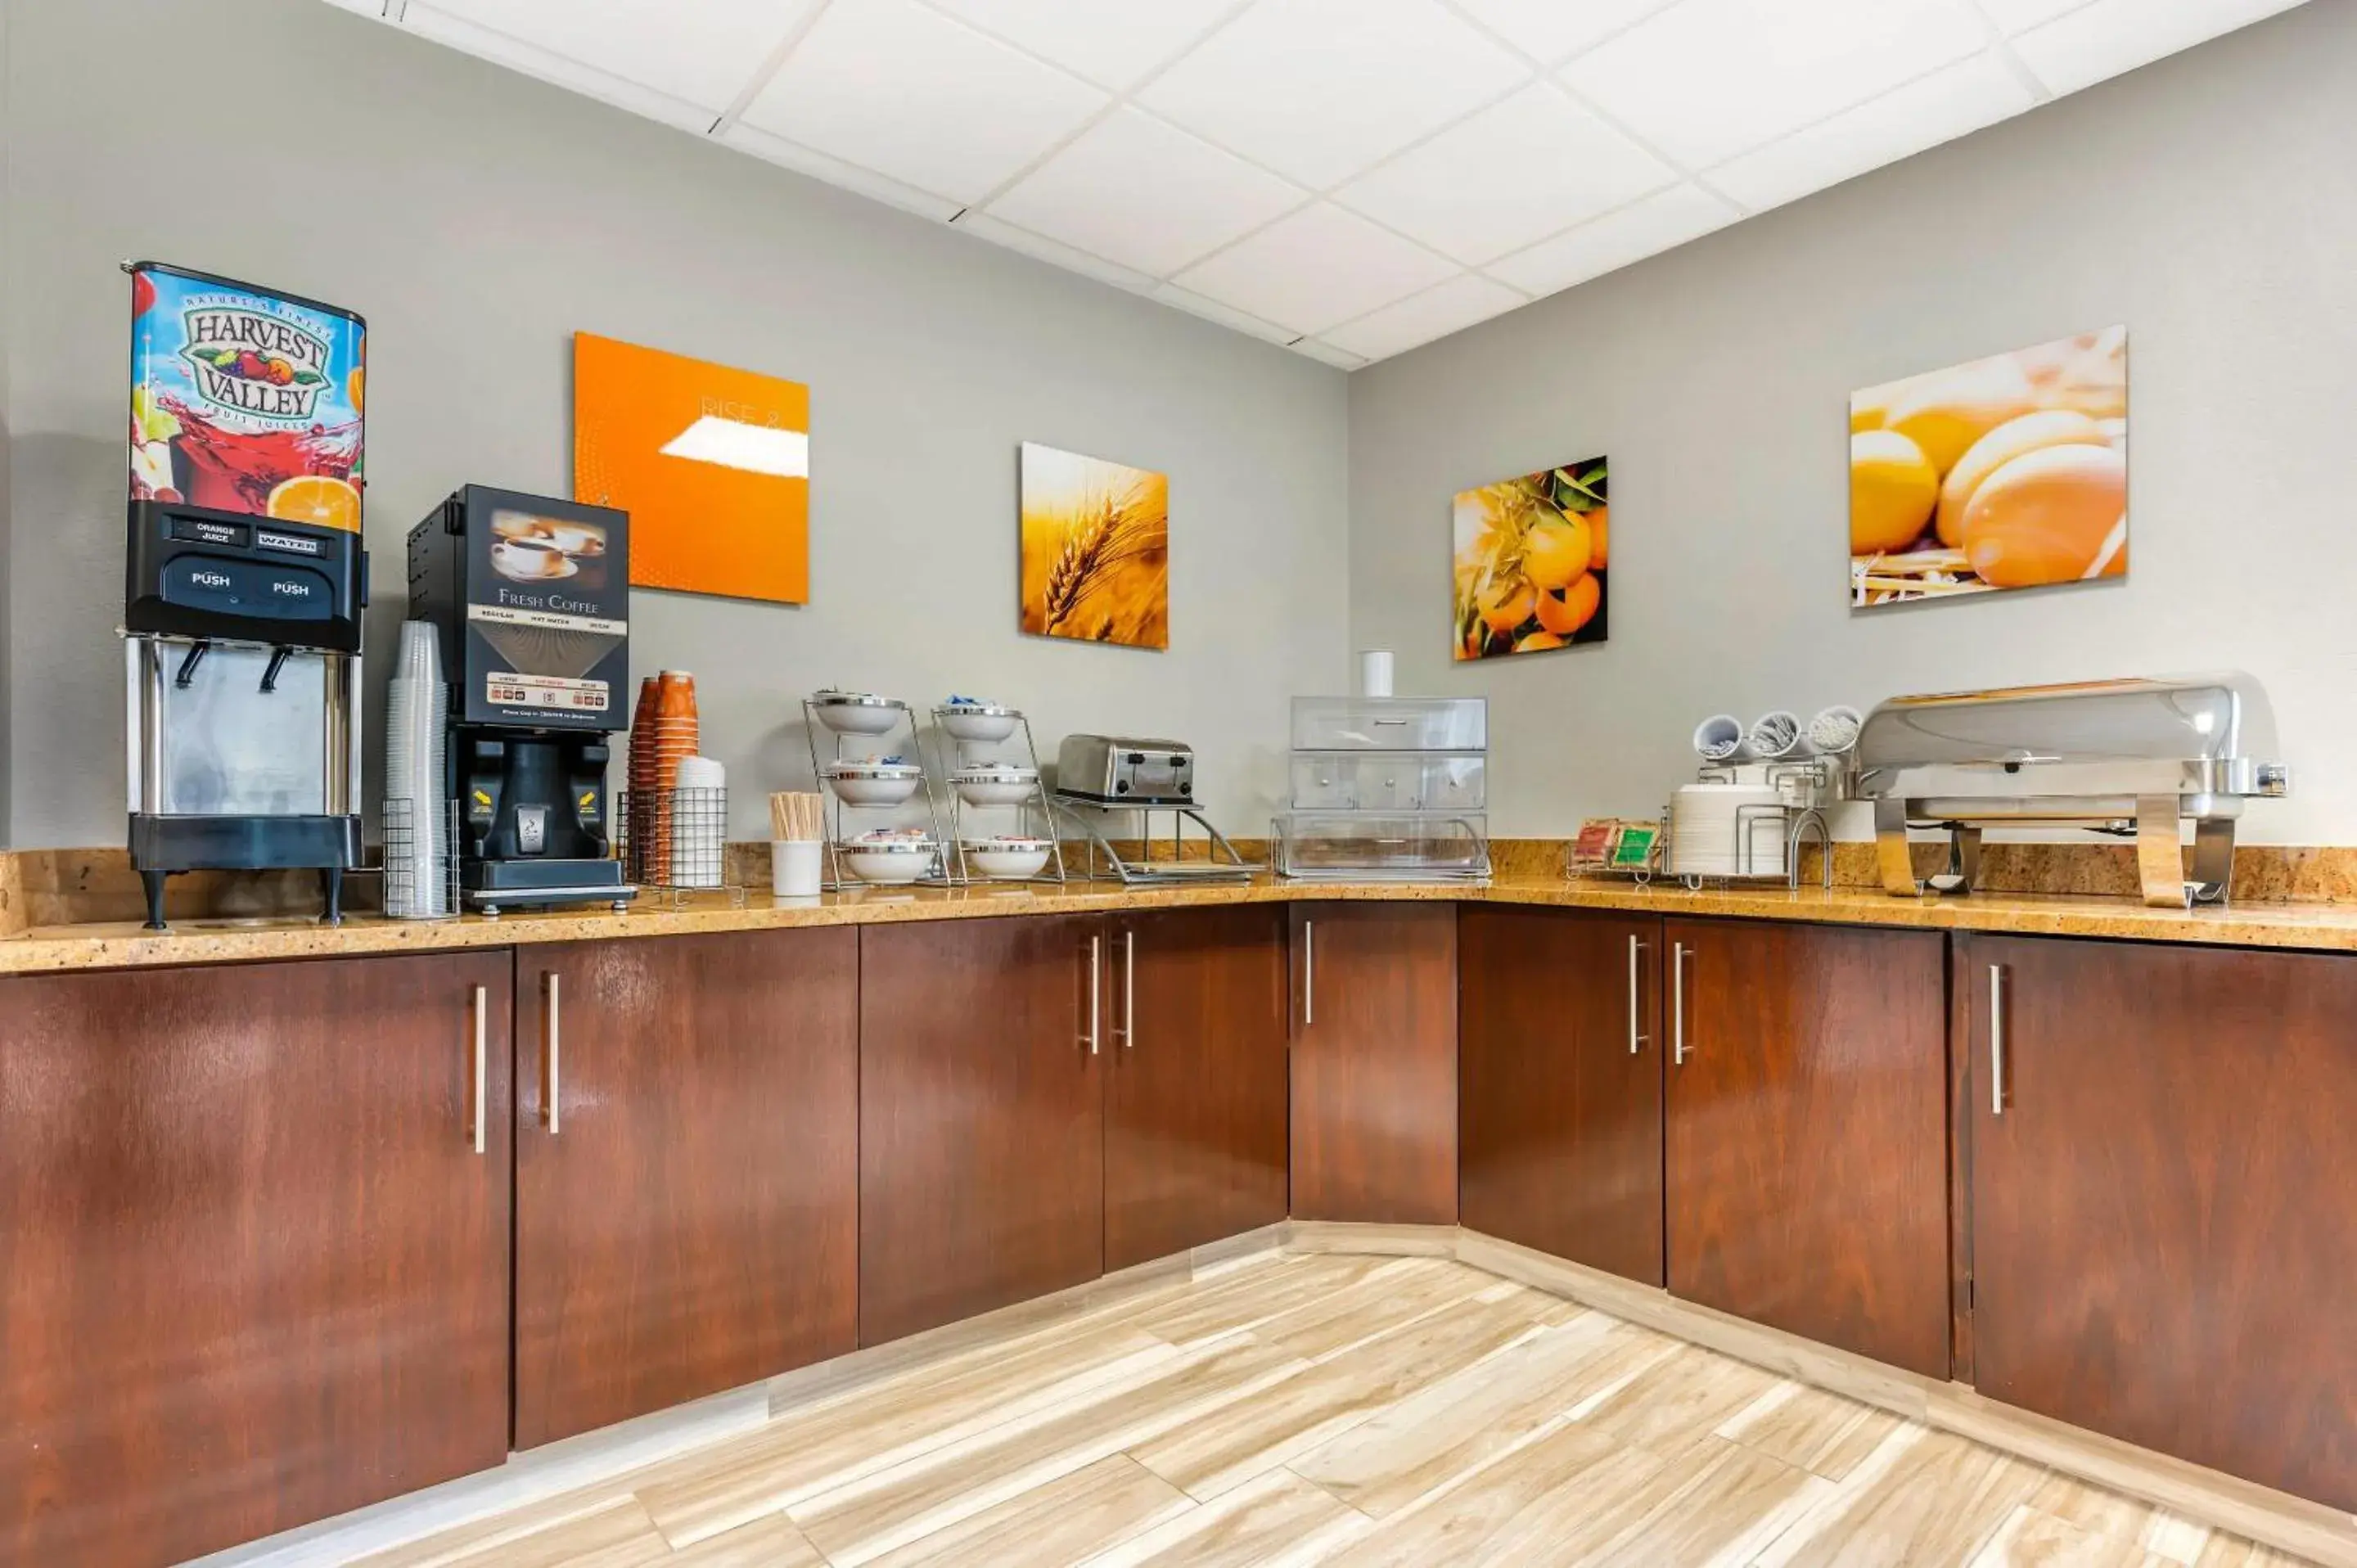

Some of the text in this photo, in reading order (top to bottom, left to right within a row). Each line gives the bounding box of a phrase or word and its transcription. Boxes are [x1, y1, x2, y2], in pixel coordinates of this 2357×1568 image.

[186, 295, 268, 310] NATURE'S
[195, 315, 323, 368] HARVEST
[205, 367, 309, 416] VALLEY
[197, 523, 235, 534] ORANGE
[202, 534, 229, 543] JUICE
[261, 536, 317, 552] WATER
[192, 573, 230, 587] PUSH
[273, 583, 309, 596] PUSH
